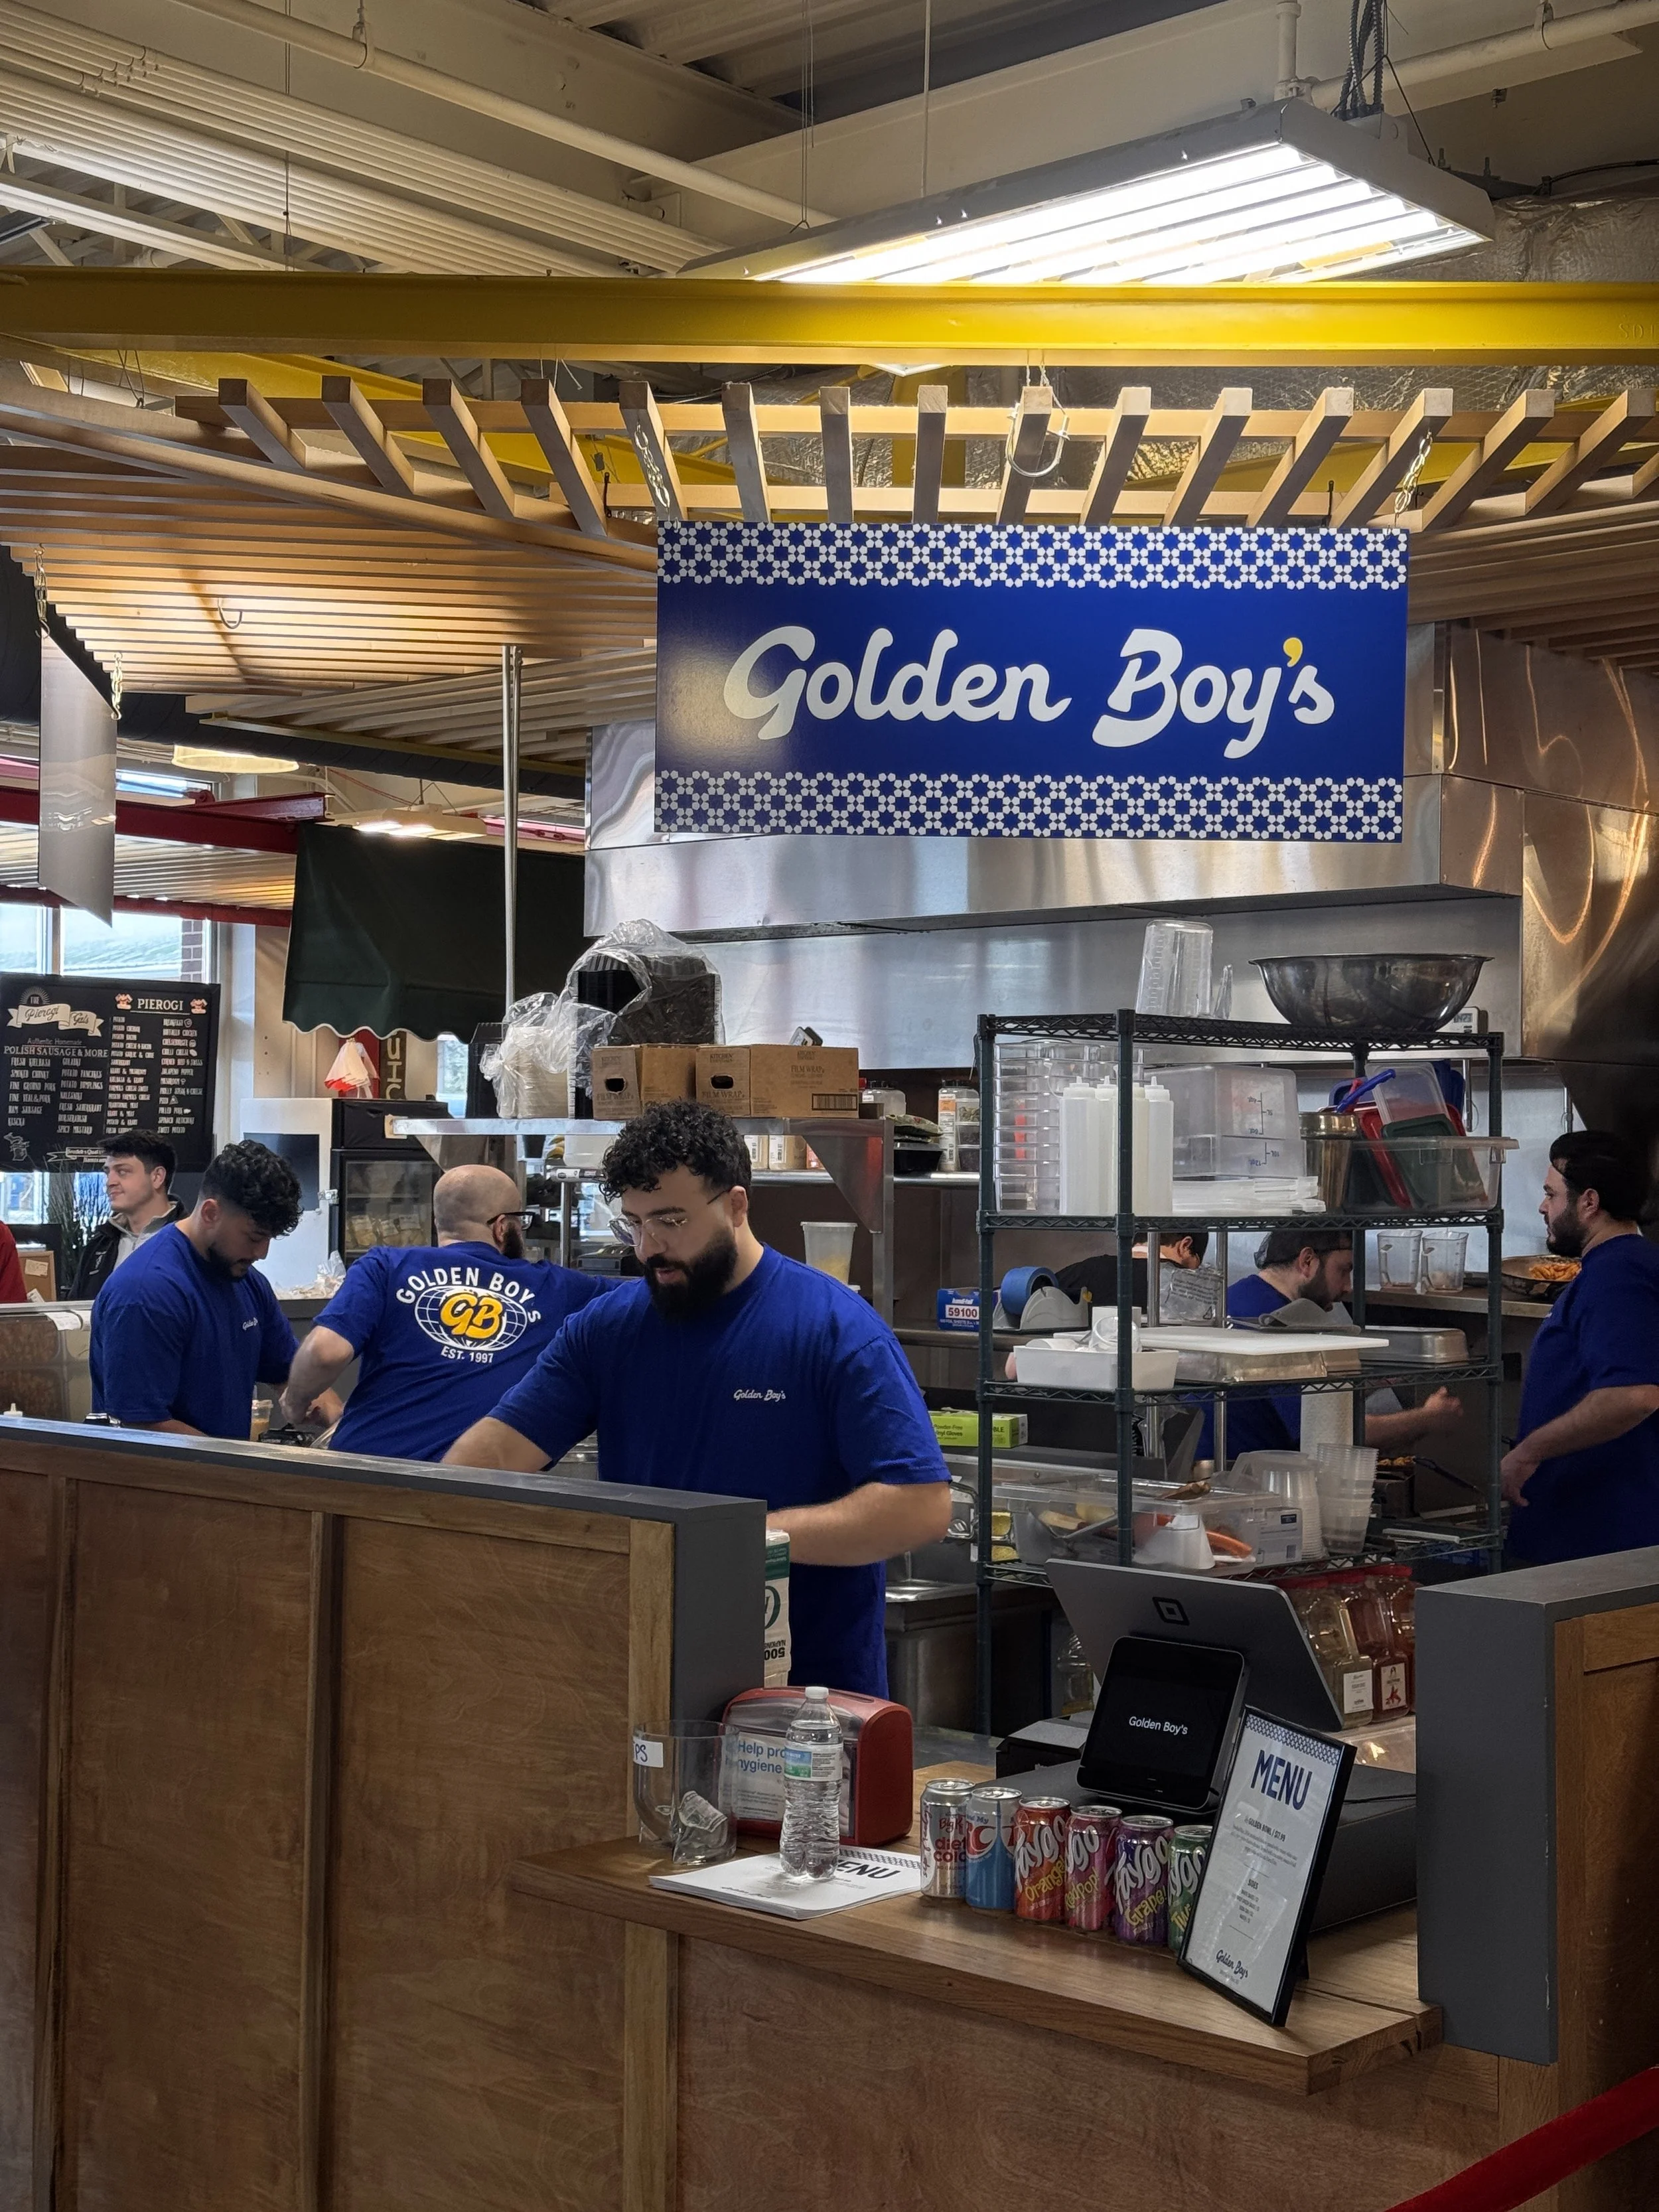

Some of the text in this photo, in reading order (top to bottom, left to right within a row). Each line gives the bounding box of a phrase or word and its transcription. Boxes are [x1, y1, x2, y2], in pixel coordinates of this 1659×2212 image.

[722, 625, 1334, 759] Golden Boy's
[25, 1005, 59, 1022] Pierogi
[137, 998, 184, 1011] PIEROGI
[3, 1045, 36, 1055] POLISH
[36, 1047, 77, 1057] SAUSAGE
[84, 1049, 109, 1058] MORE
[396, 1266, 480, 1304] GOLDEN
[440, 1292, 503, 1339] GB
[948, 1307, 977, 1318] 59100
[440, 1346, 494, 1363] EST. 1997
[733, 1389, 786, 1402] Golden Boy's
[764, 1647, 785, 1660] 500
[1128, 1716, 1189, 1735] Golden Boy's
[738, 1740, 764, 1757] Help
[1250, 1749, 1313, 1810] MENU
[836, 1860, 901, 1879] ENU
[1124, 1885, 1167, 1926] Grape!
[1216, 1949, 1234, 1970] Golden
